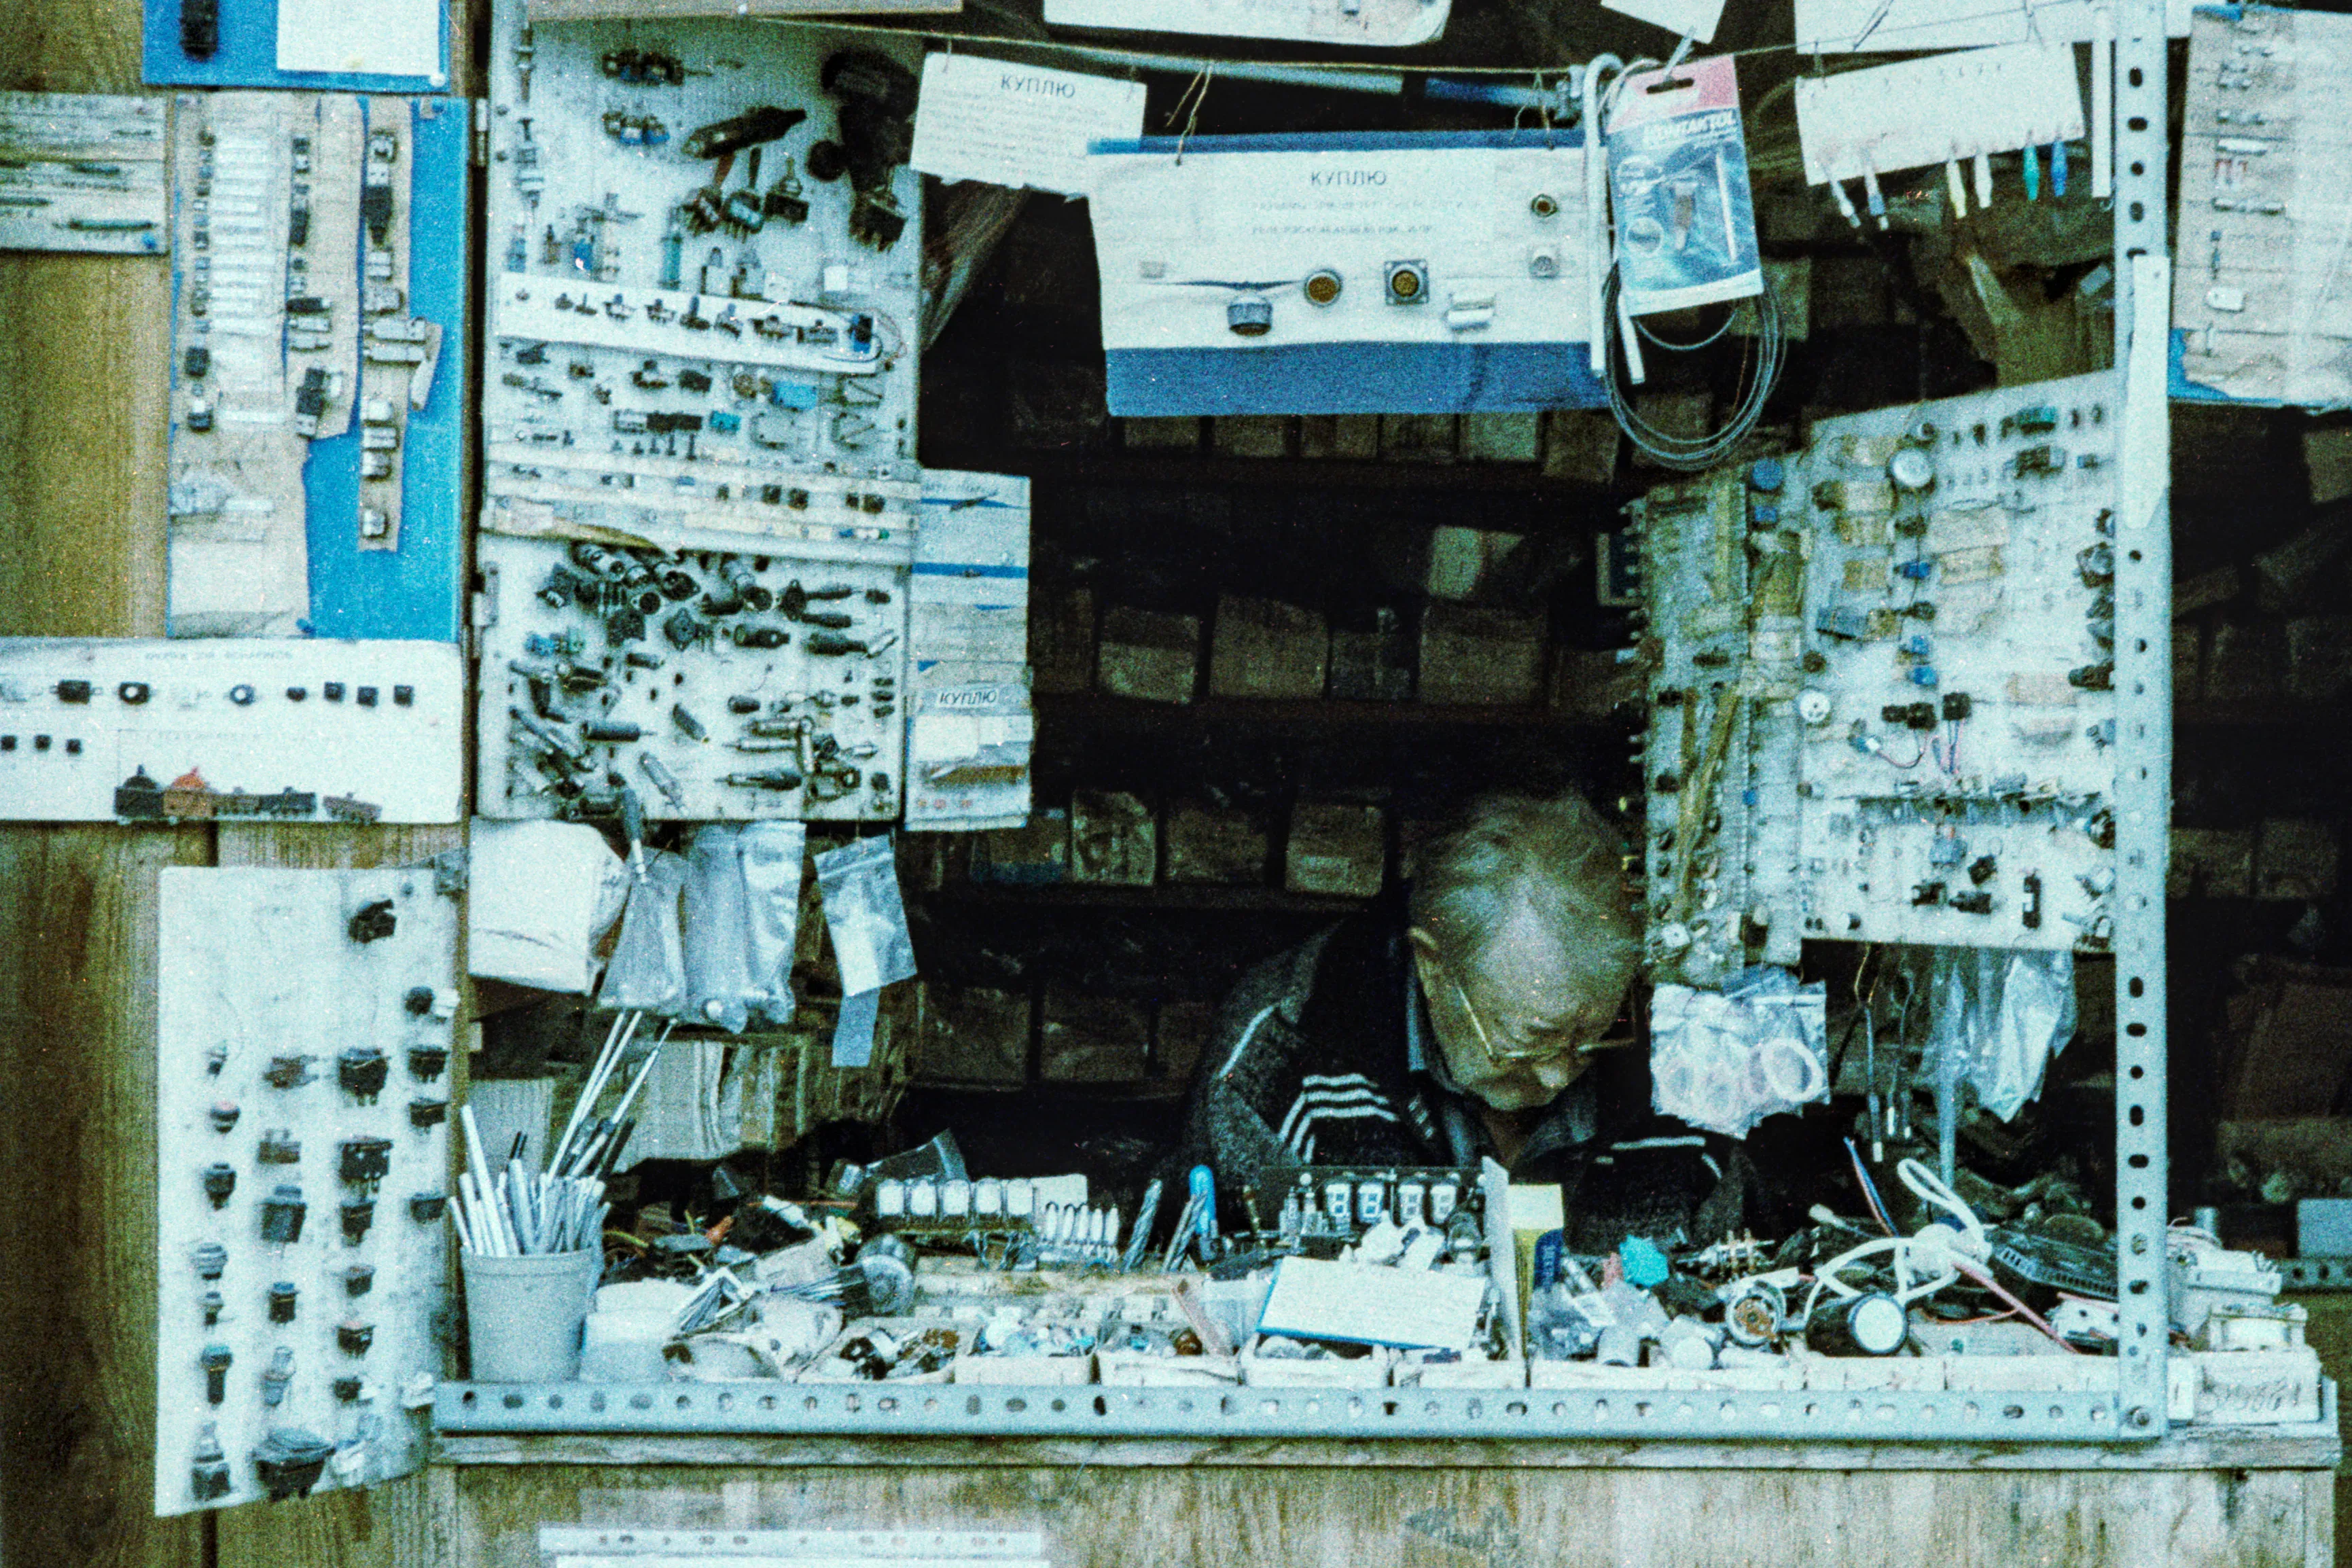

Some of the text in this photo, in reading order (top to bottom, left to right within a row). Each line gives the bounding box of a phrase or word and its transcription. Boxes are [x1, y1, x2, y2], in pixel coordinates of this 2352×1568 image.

[1001, 75, 1075, 98] КУПЛЮ
[1311, 171, 1387, 186] КУПЛЮ
[940, 690, 997, 705] КУПЛЮ
